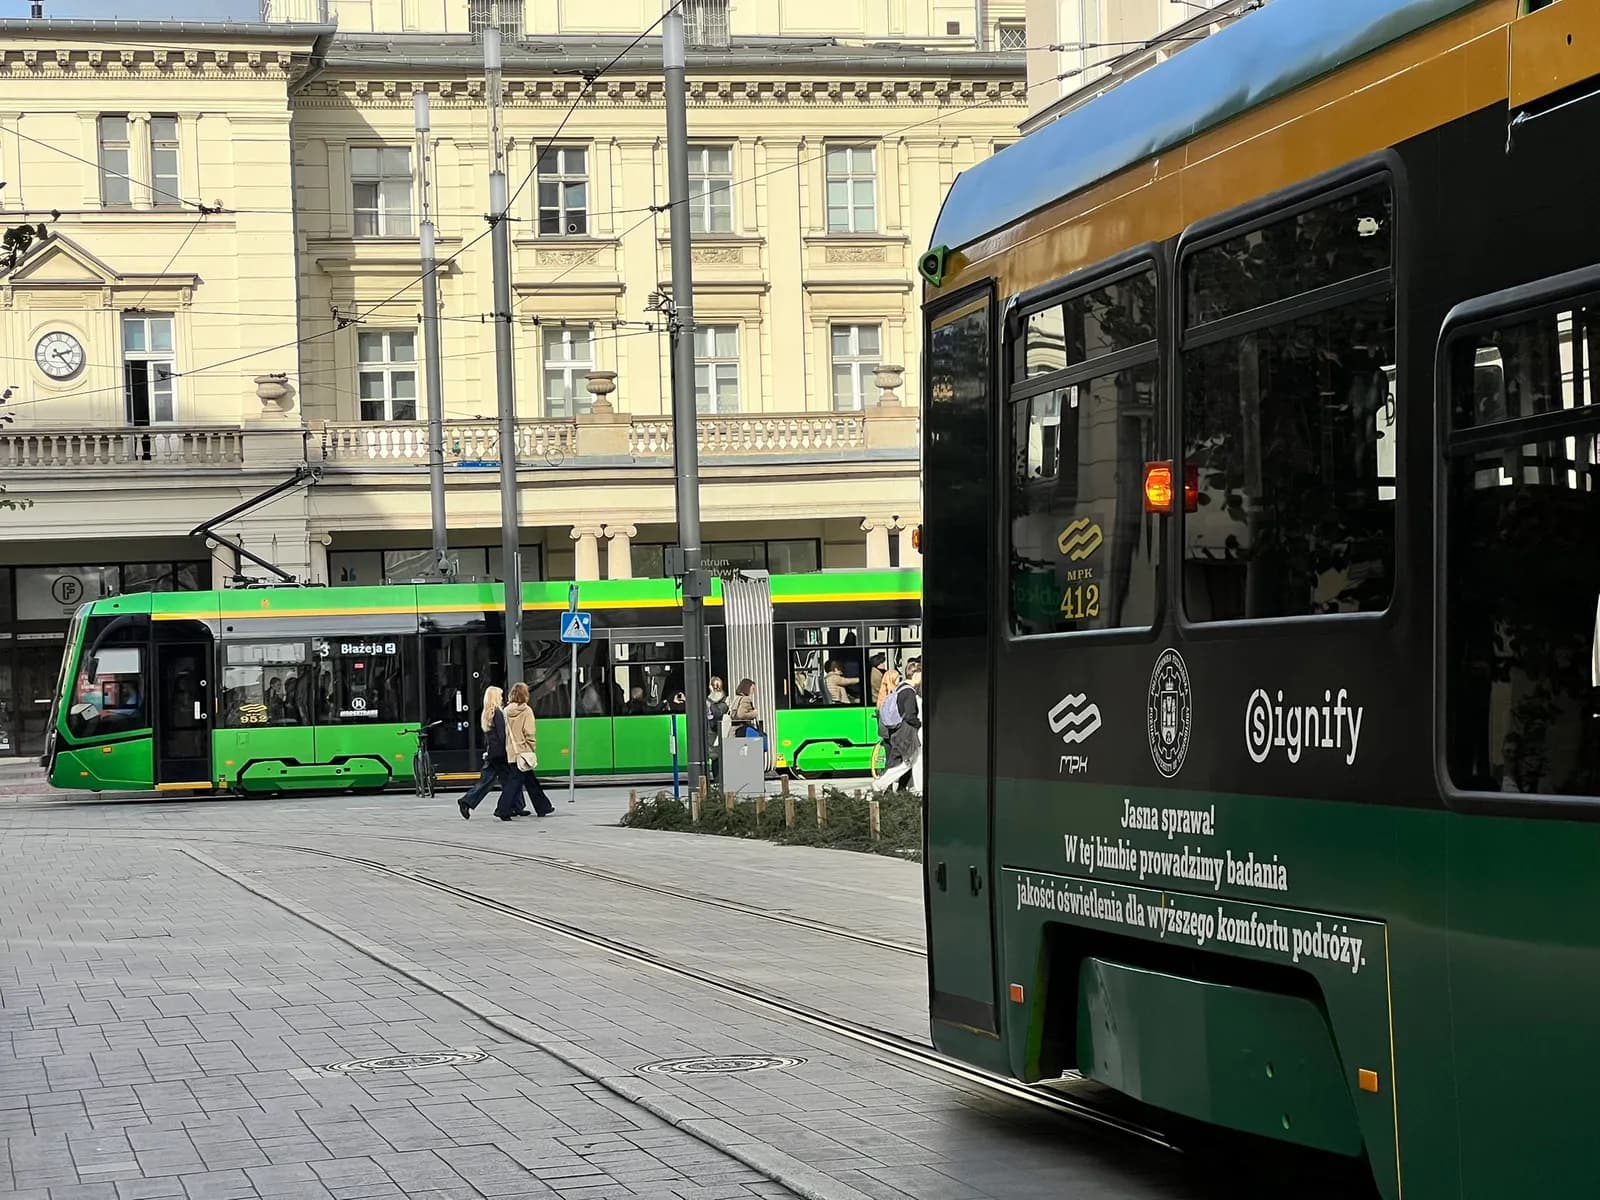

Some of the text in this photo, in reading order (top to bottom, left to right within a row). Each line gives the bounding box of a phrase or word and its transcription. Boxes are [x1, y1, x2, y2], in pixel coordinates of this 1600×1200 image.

[700, 558, 730, 567] ntrum
[1067, 567, 1094, 581] MPK
[1060, 584, 1099, 619] 412
[319, 642, 383, 657] 3 Błażeja
[1121, 799, 1215, 839] Jasna sprawa!
[1064, 834, 1288, 891] W tej bimbie prowadzimy badania
[1017, 875, 1366, 974] jakości oświetlenia dla wyższego komfortu podróży.
